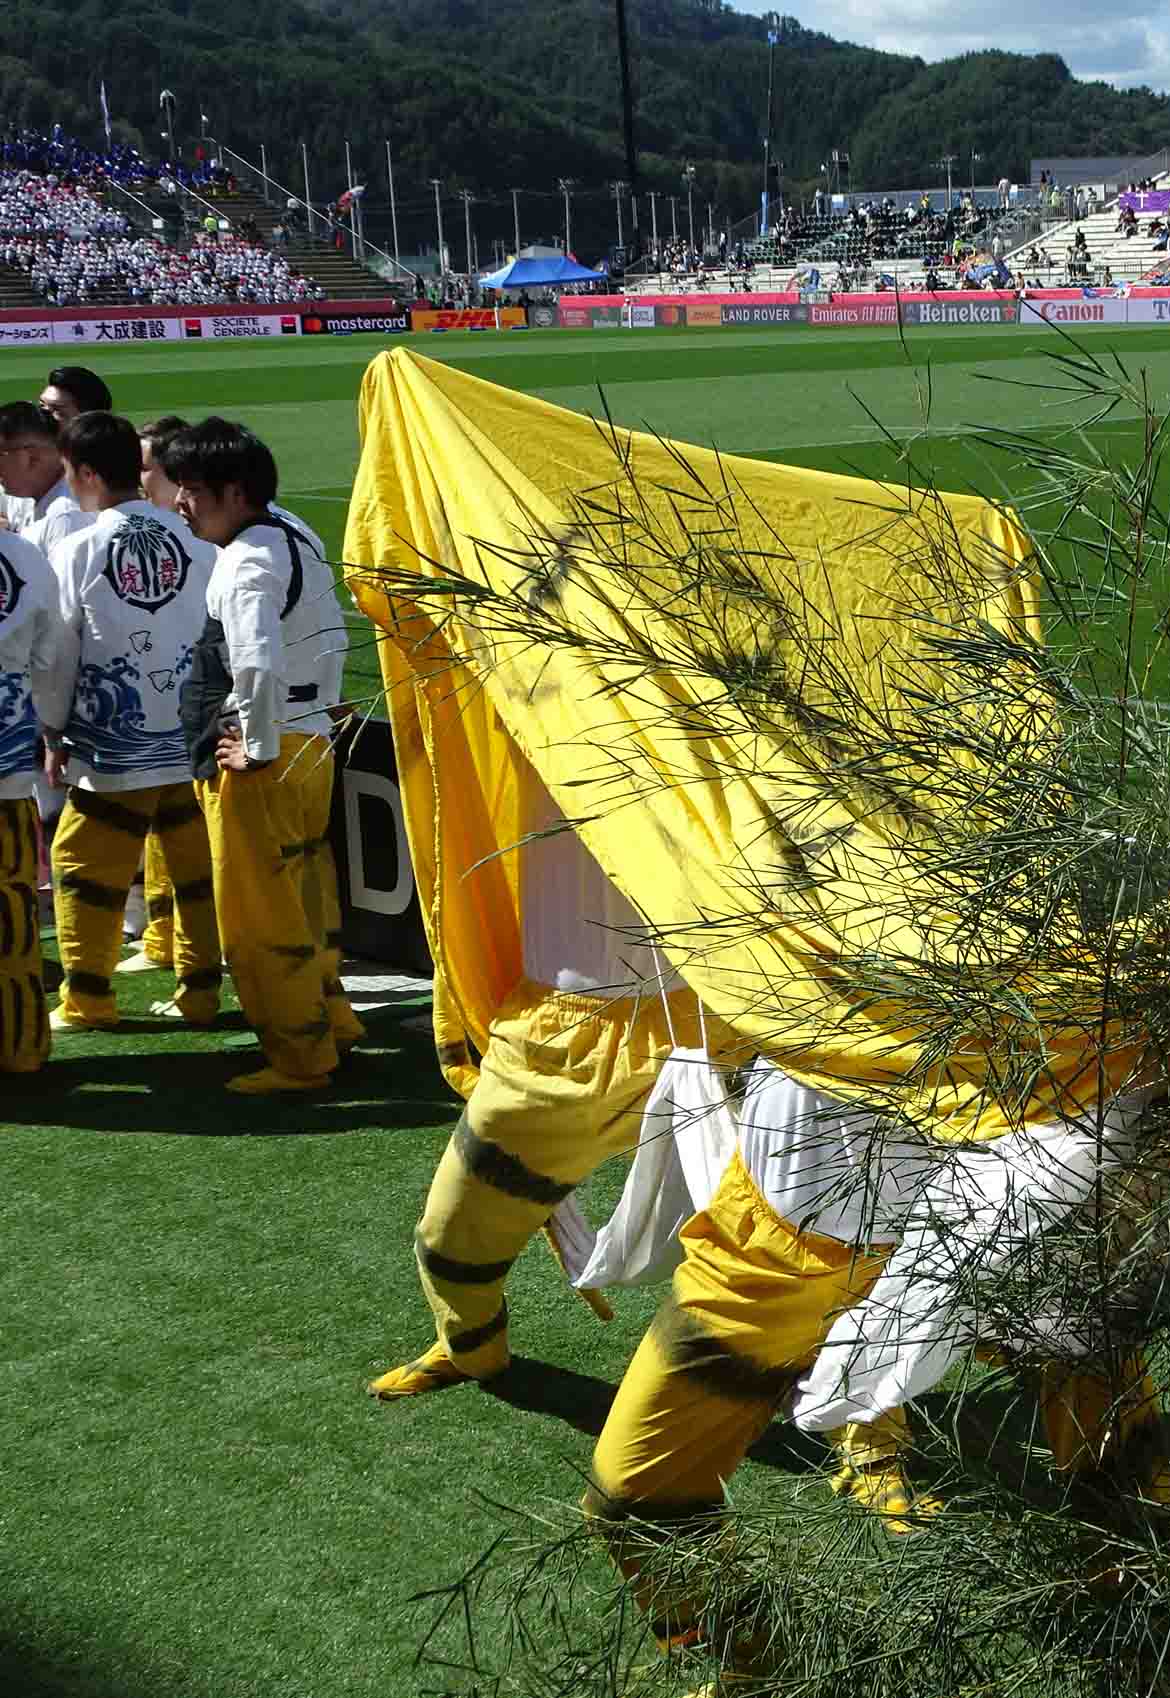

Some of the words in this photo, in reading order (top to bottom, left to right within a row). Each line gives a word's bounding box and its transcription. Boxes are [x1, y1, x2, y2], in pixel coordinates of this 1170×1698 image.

[722, 309, 750, 321] LAND
[754, 308, 791, 321] ROVER
[811, 305, 859, 321] Emirates
[919, 303, 1001, 322] Heineken
[1040, 301, 1104, 321] Canon
[95, 320, 166, 340] 大成建設
[327, 315, 407, 331] mastercard
